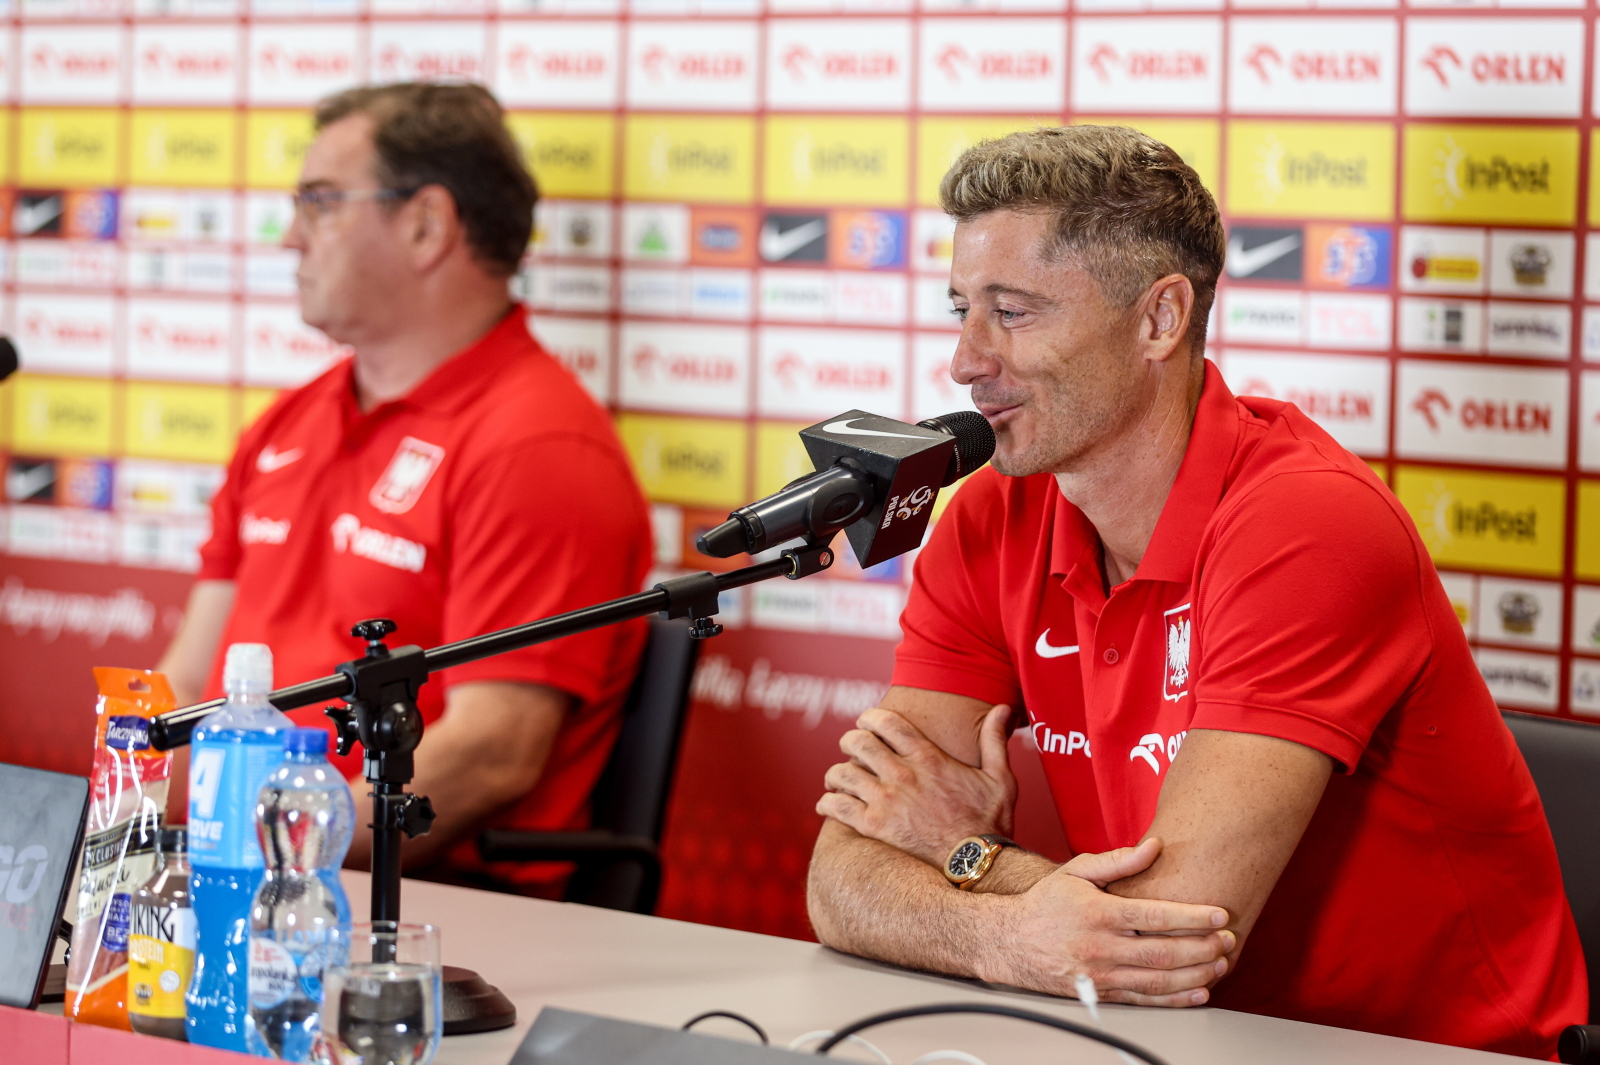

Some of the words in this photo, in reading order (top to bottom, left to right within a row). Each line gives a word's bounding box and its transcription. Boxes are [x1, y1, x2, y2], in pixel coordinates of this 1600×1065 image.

[1290, 52, 1381, 82] ORLEN
[1471, 53, 1566, 84] ORLEN
[1466, 155, 1550, 194] InPost
[1460, 399, 1552, 434] ORLEN
[881, 495, 900, 530] POLSKA
[1453, 501, 1537, 543] InPost
